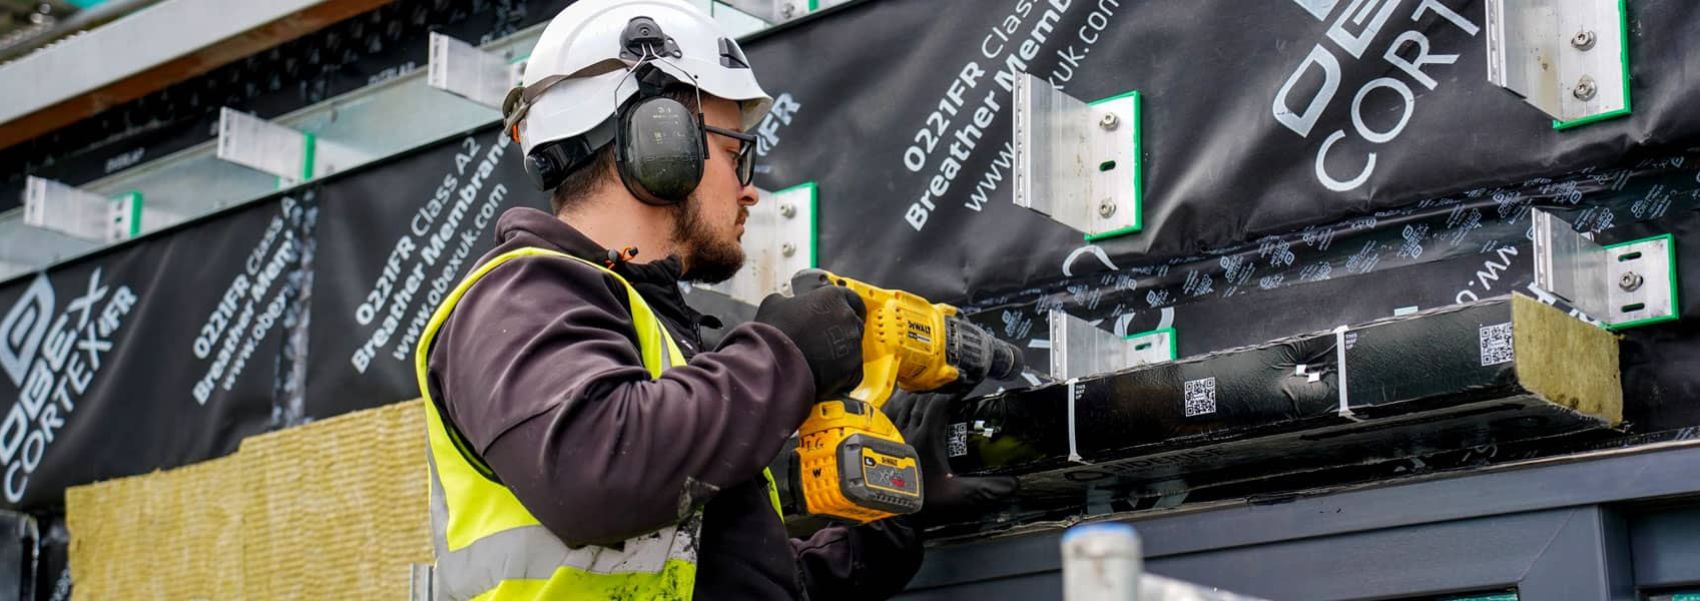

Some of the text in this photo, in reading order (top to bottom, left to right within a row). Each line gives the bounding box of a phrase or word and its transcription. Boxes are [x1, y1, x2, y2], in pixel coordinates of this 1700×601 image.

[903, 0, 1039, 173] 0221FR Clas
[904, 89, 1002, 233] Breather
[192, 300, 255, 406] Breather
[251, 230, 295, 303] Mem
[193, 274, 251, 360] 0221FR
[245, 214, 284, 276] Class
[280, 196, 297, 219] A
[351, 130, 513, 375] Breather Membrane
[356, 136, 482, 327] 0221FR Class A2
[393, 182, 508, 362] www.obexuk.com
